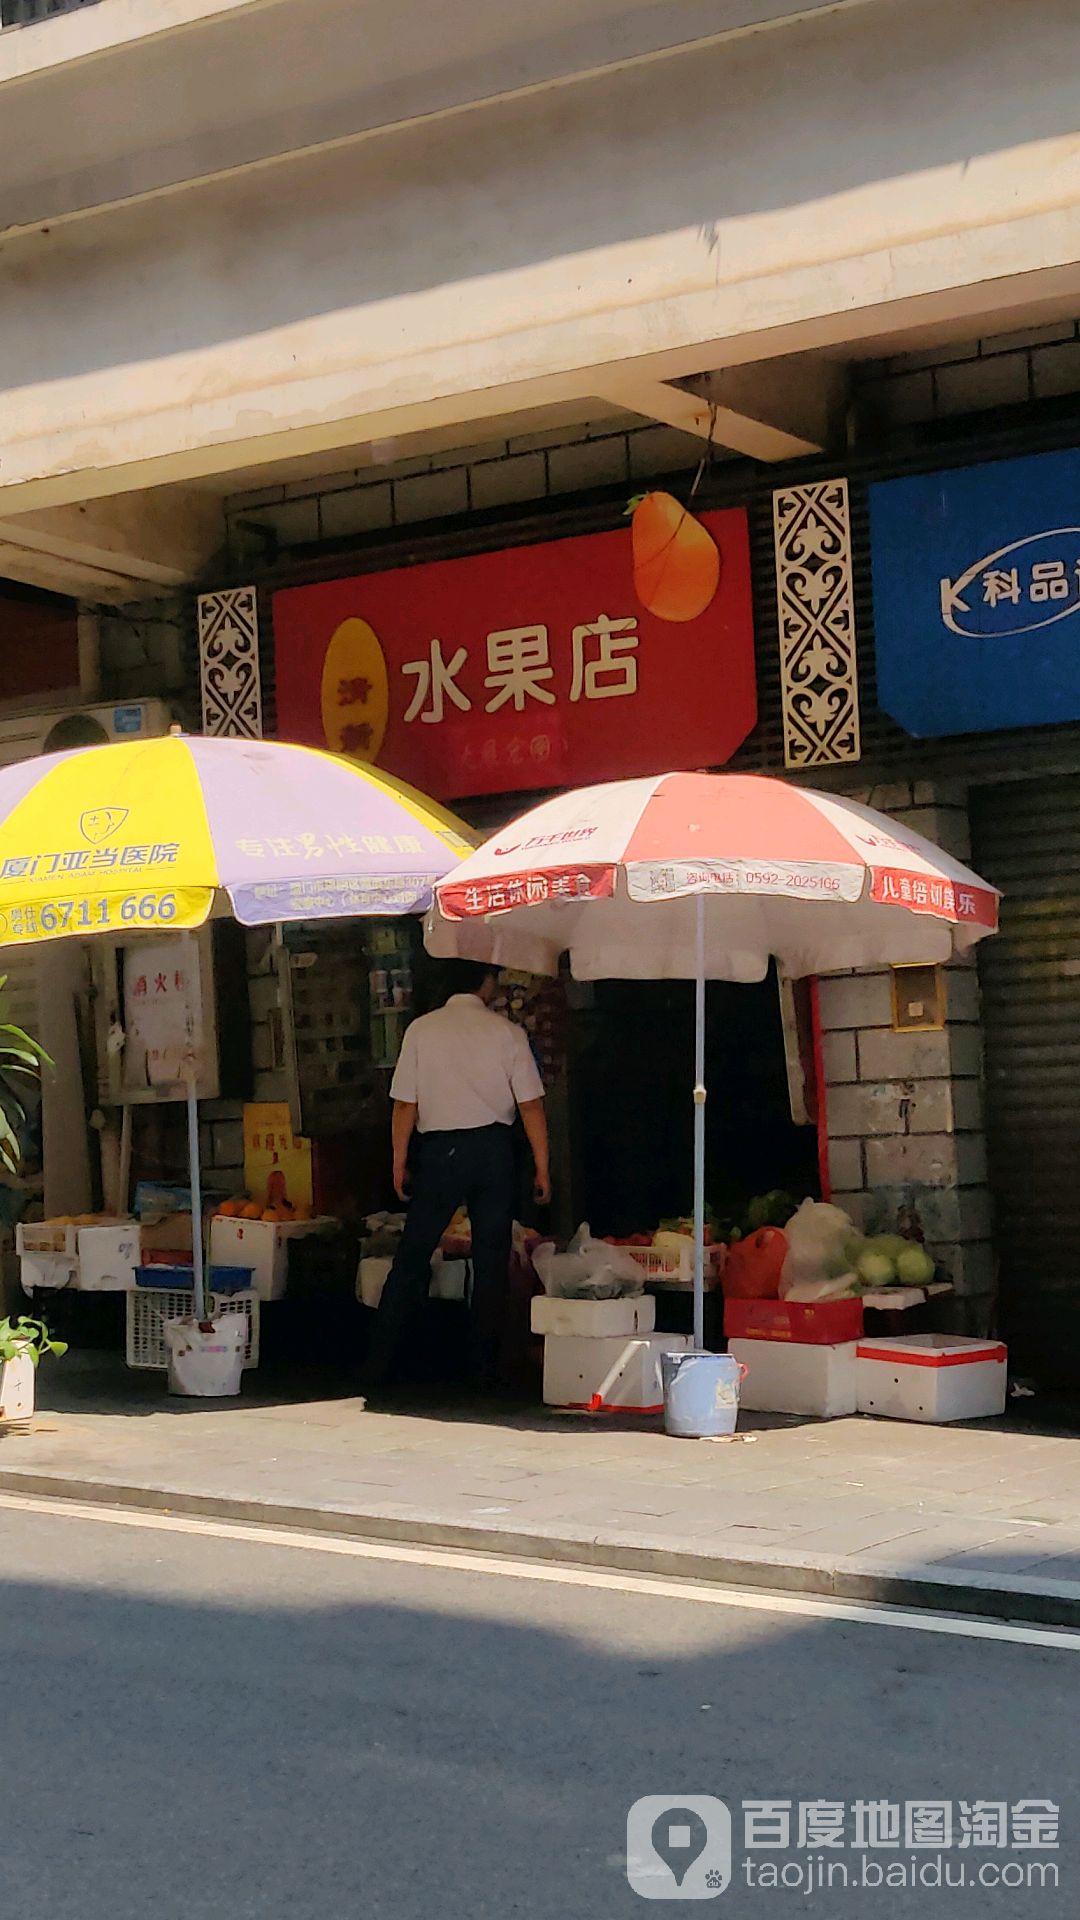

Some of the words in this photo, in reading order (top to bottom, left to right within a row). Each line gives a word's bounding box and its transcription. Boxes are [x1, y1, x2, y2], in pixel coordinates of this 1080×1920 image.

[983, 559, 1080, 608] 科品
[402, 614, 639, 723] 水果店
[0, 843, 180, 879] 厦门亚当医院
[465, 873, 592, 911] 生活休闲美食
[745, 871, 841, 891] 0592-2025166
[882, 875, 977, 915] 儿童培训娱乐
[40, 898, 110, 931] 6711
[121, 893, 176, 920] 666
